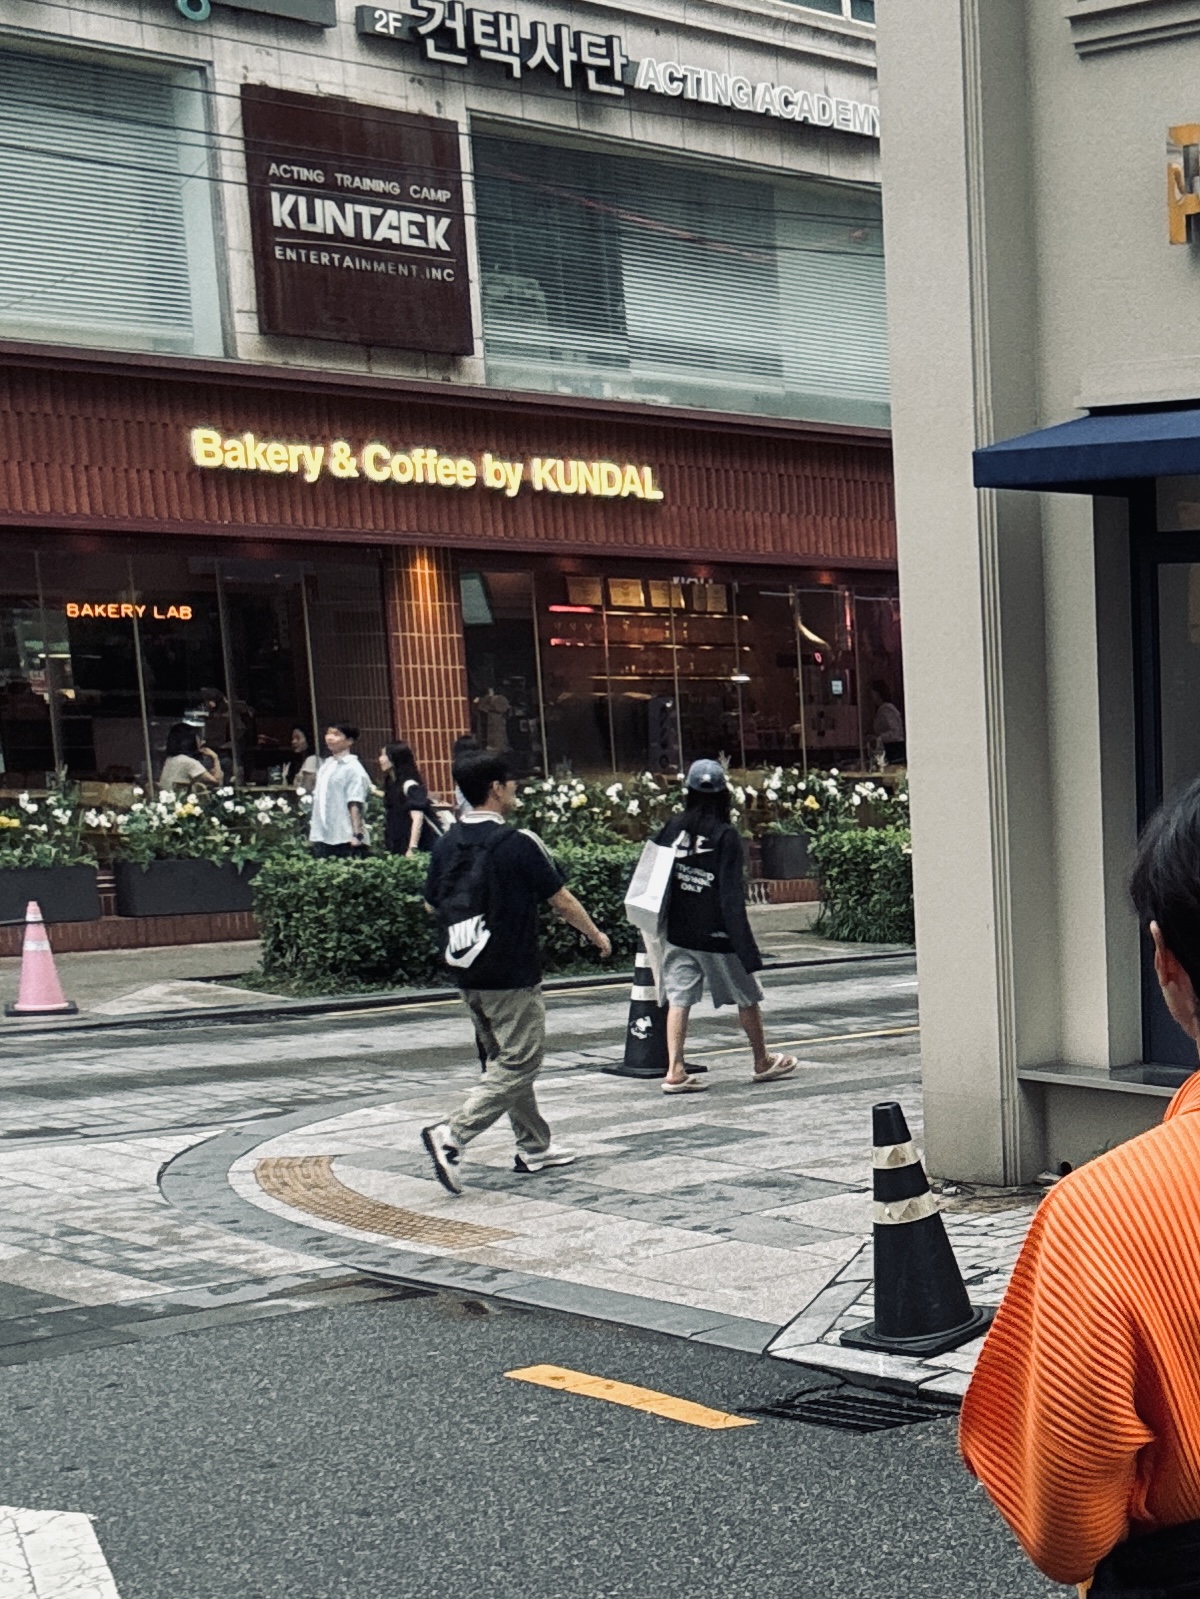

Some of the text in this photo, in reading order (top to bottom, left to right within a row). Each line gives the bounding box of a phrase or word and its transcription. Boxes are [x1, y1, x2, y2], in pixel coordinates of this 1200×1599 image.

[374, 9, 402, 35] 2F
[412, 0, 626, 97] 건택사단
[638, 58, 753, 112] ACTING
[268, 163, 452, 203] ACTING TRAINING CAMP
[269, 191, 452, 252] KUNTAEK
[191, 427, 665, 501] Bakery & Coffee by KUNDAL
[66, 603, 192, 620] BAKERY LAB
